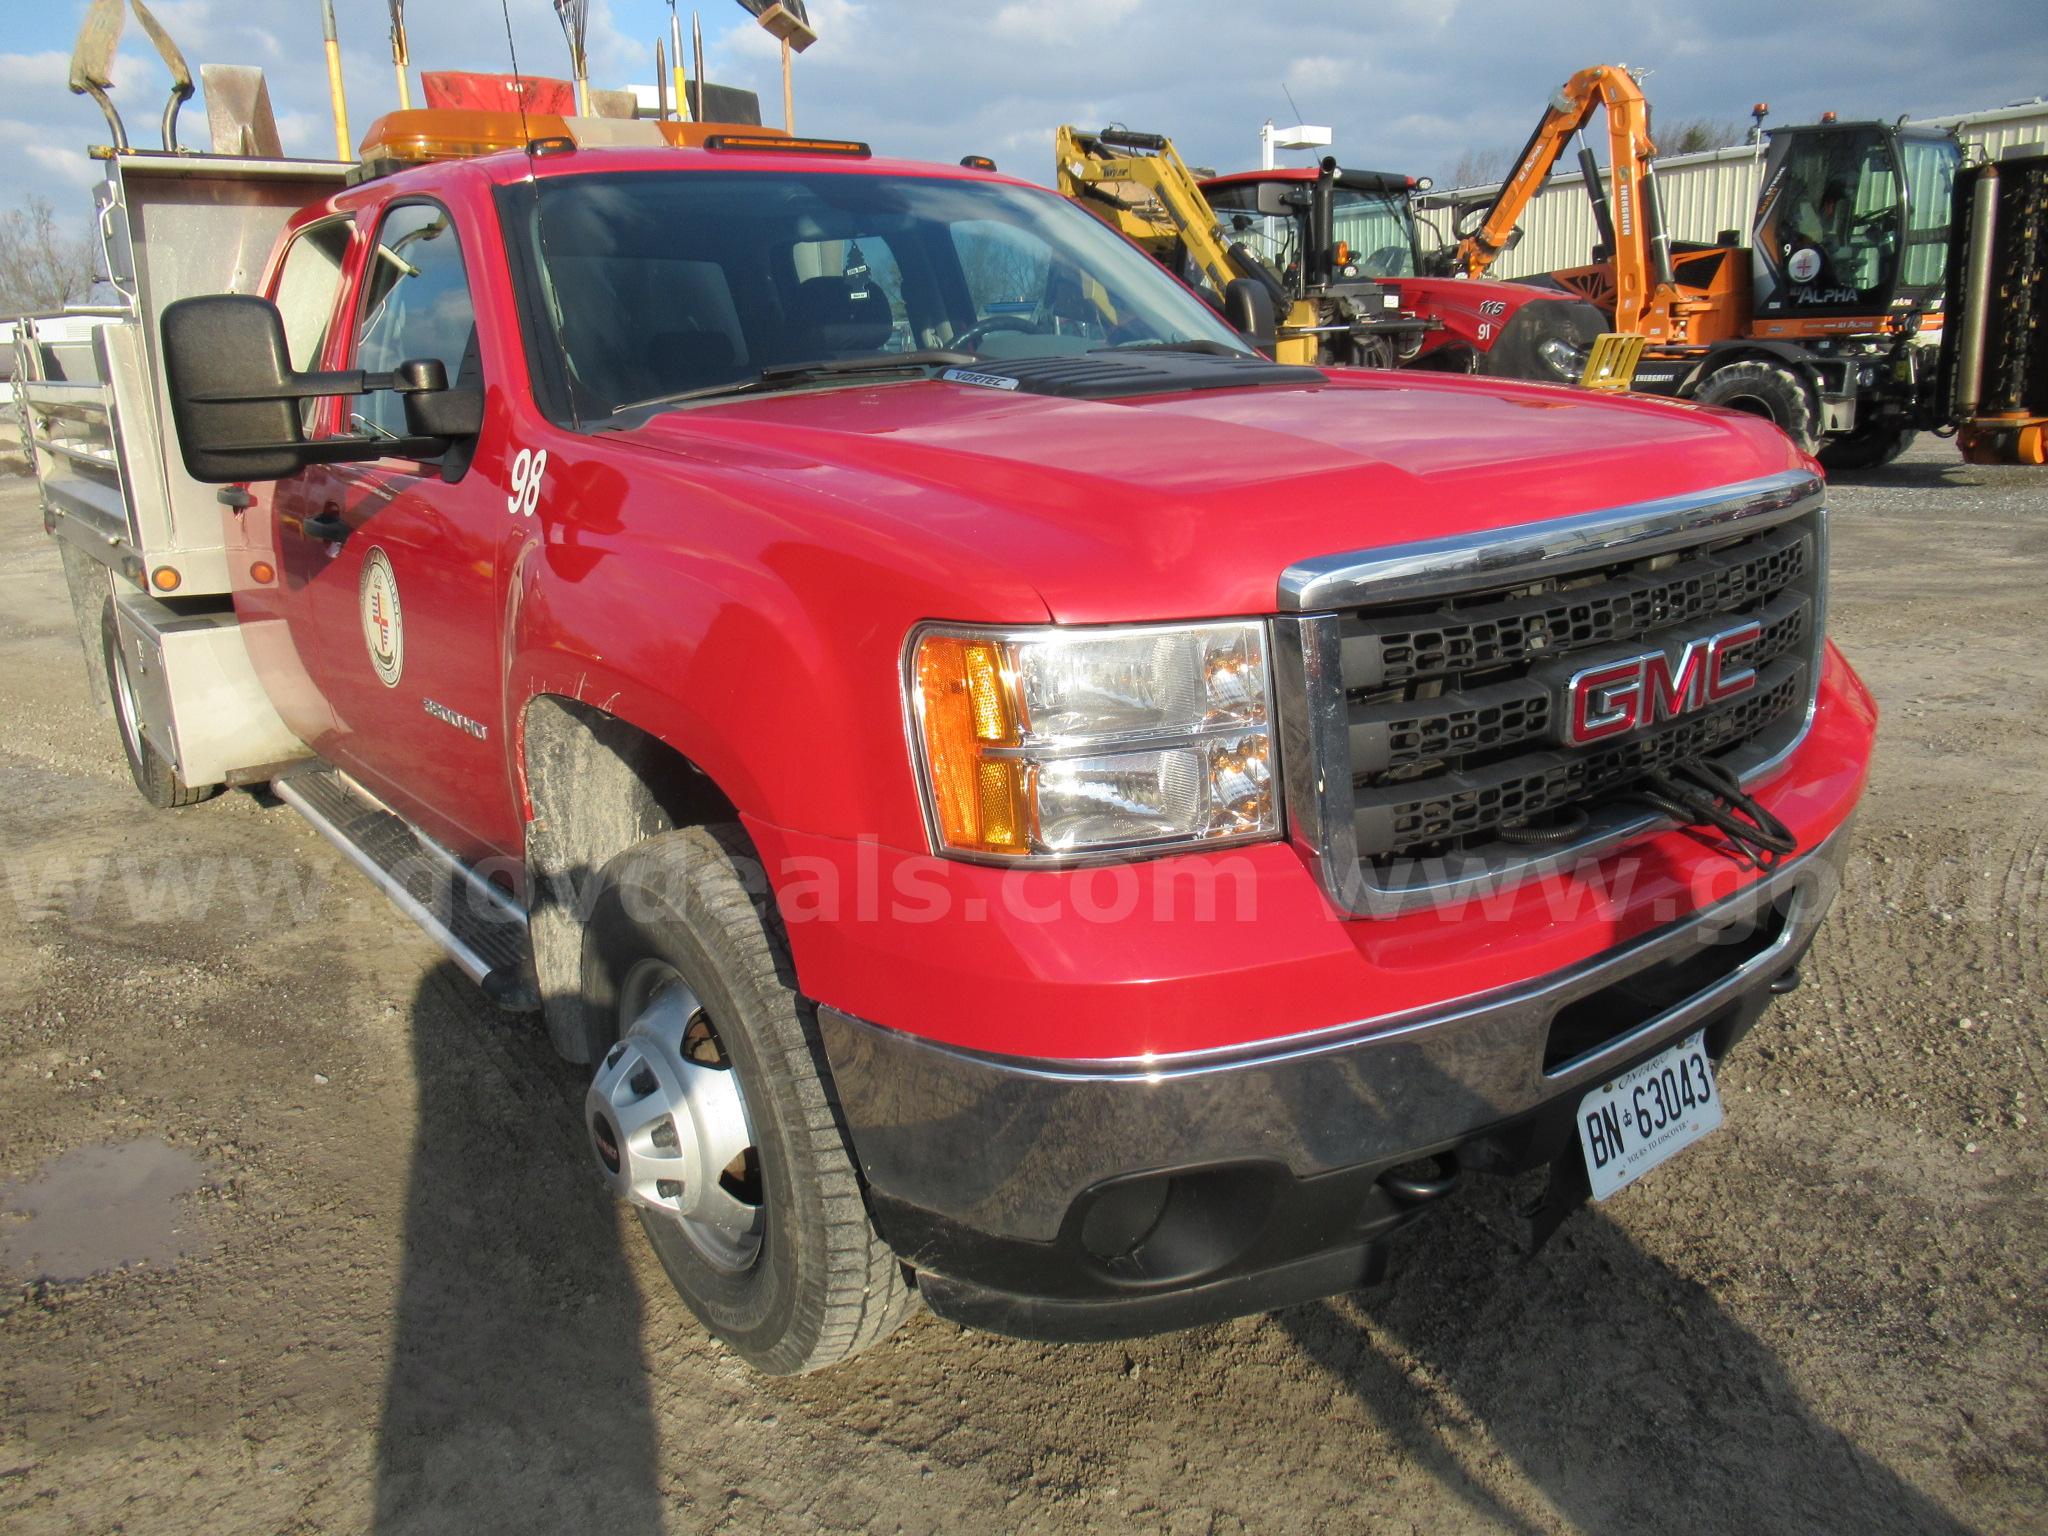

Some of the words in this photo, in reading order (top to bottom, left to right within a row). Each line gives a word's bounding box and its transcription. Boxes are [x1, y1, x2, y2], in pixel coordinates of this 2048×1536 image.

[1621, 184, 1631, 236] ENERGREEN
[1798, 286, 1859, 304] ALPHA
[1479, 300, 1506, 315] 115
[1478, 324, 1490, 341] 91
[954, 371, 1007, 386] VORTEC
[1635, 374, 1675, 382] ENERGREEN
[507, 447, 547, 517] 98
[1564, 620, 1761, 748] GMC
[1632, 1053, 1711, 1139] 63043
